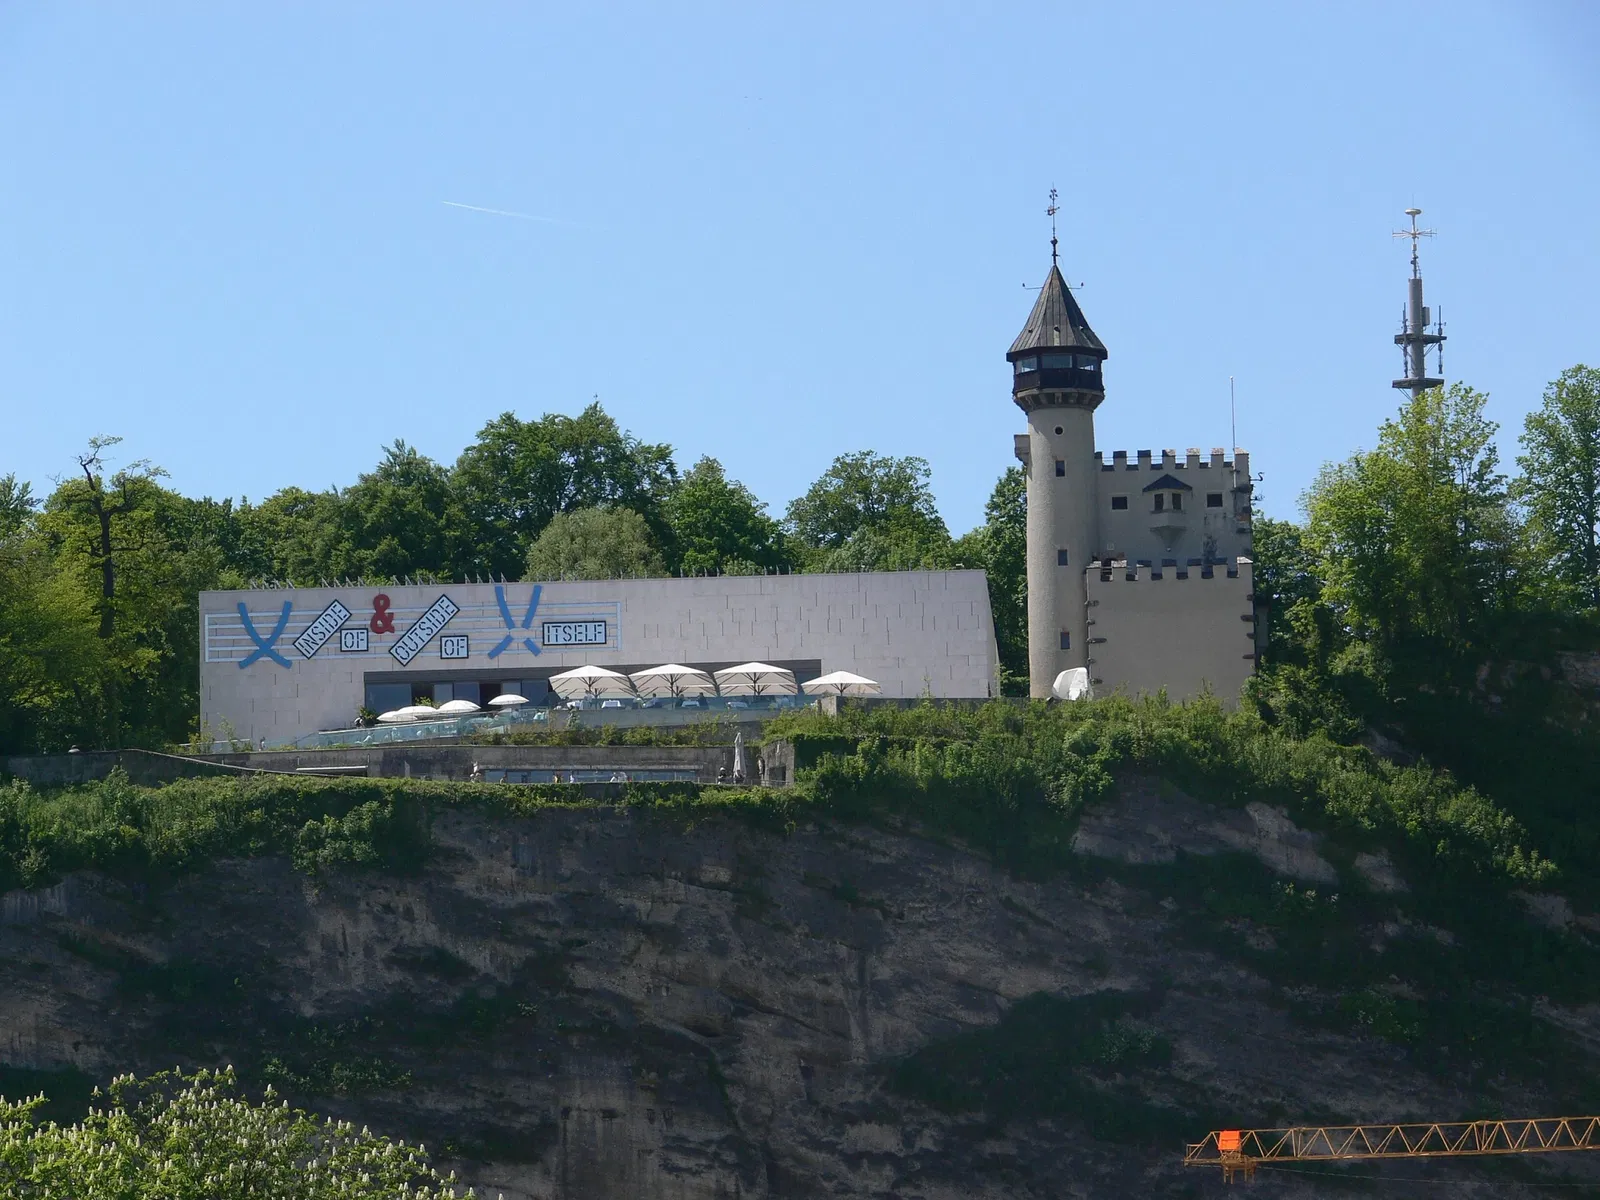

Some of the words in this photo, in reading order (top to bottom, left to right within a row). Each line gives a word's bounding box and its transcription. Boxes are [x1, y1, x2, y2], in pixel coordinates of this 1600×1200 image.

[300, 603, 348, 655] INSIDE
[344, 631, 366, 649] OF
[370, 593, 395, 634] &
[395, 598, 456, 661] OUTSIDE
[444, 638, 466, 656] OF
[546, 623, 603, 642] ITSELF
